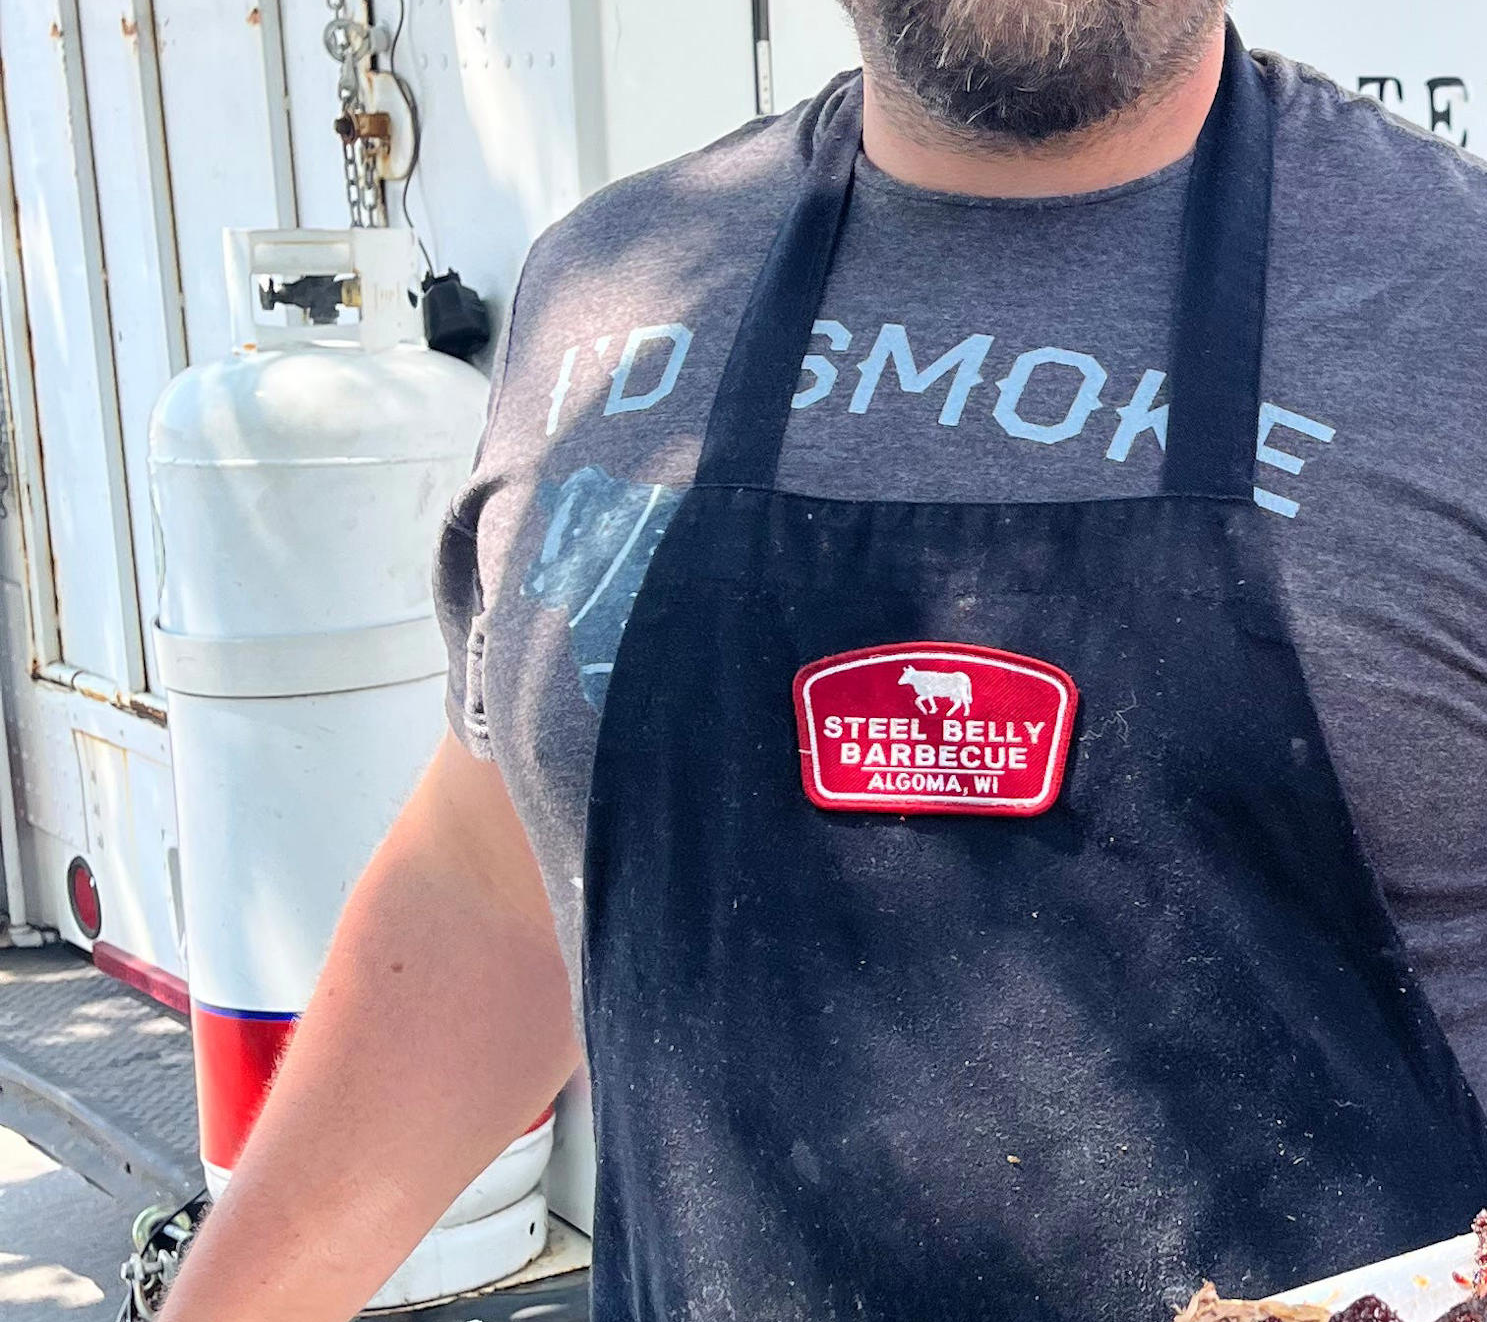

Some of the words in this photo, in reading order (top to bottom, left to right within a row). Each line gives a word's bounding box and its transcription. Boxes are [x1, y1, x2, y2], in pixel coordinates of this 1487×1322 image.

[545, 322, 694, 436] I'D
[823, 715, 927, 742] STEEL
[942, 719, 1046, 745] BELLY
[840, 743, 1028, 770] BARBECUE
[867, 773, 968, 796] ALGOMA,
[974, 776, 999, 794] WI
